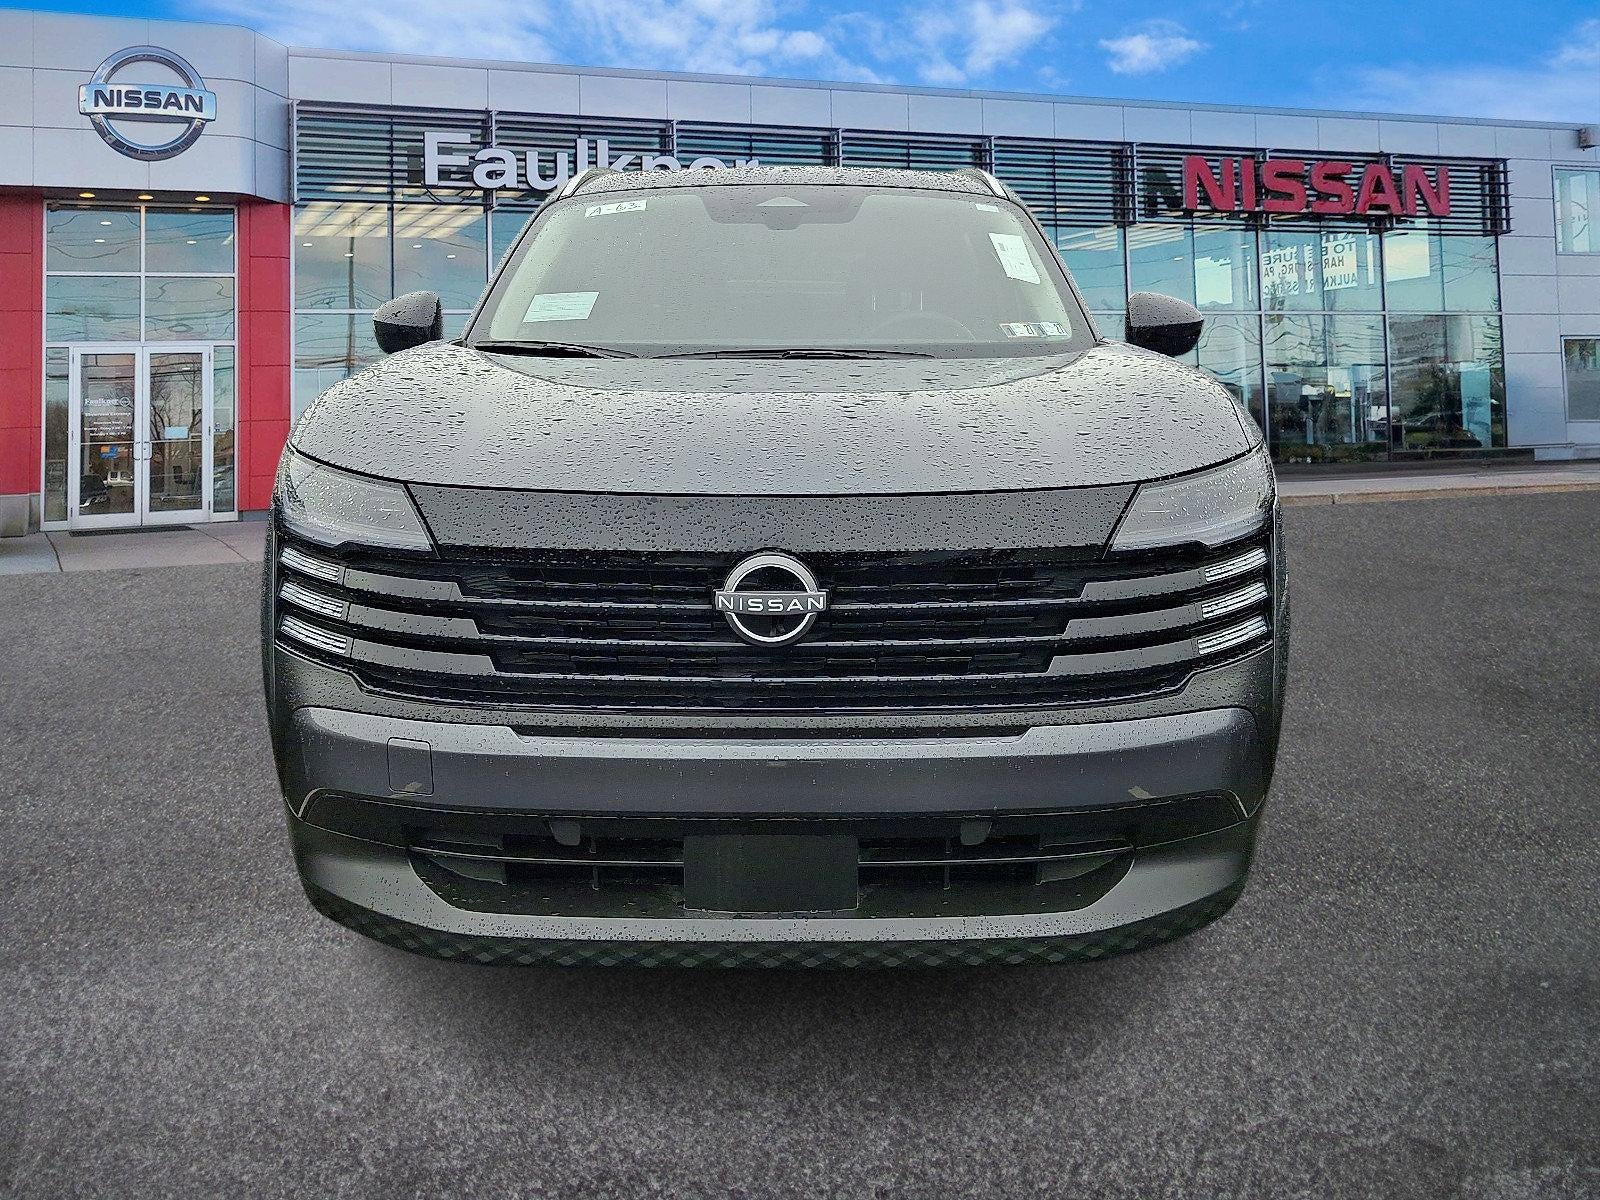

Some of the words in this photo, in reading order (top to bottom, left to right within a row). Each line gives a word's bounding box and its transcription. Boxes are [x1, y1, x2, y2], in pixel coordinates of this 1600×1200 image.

[93, 89, 204, 113] NISSAN
[1182, 155, 1450, 216] NISSAN
[718, 595, 825, 612] NISSAN
